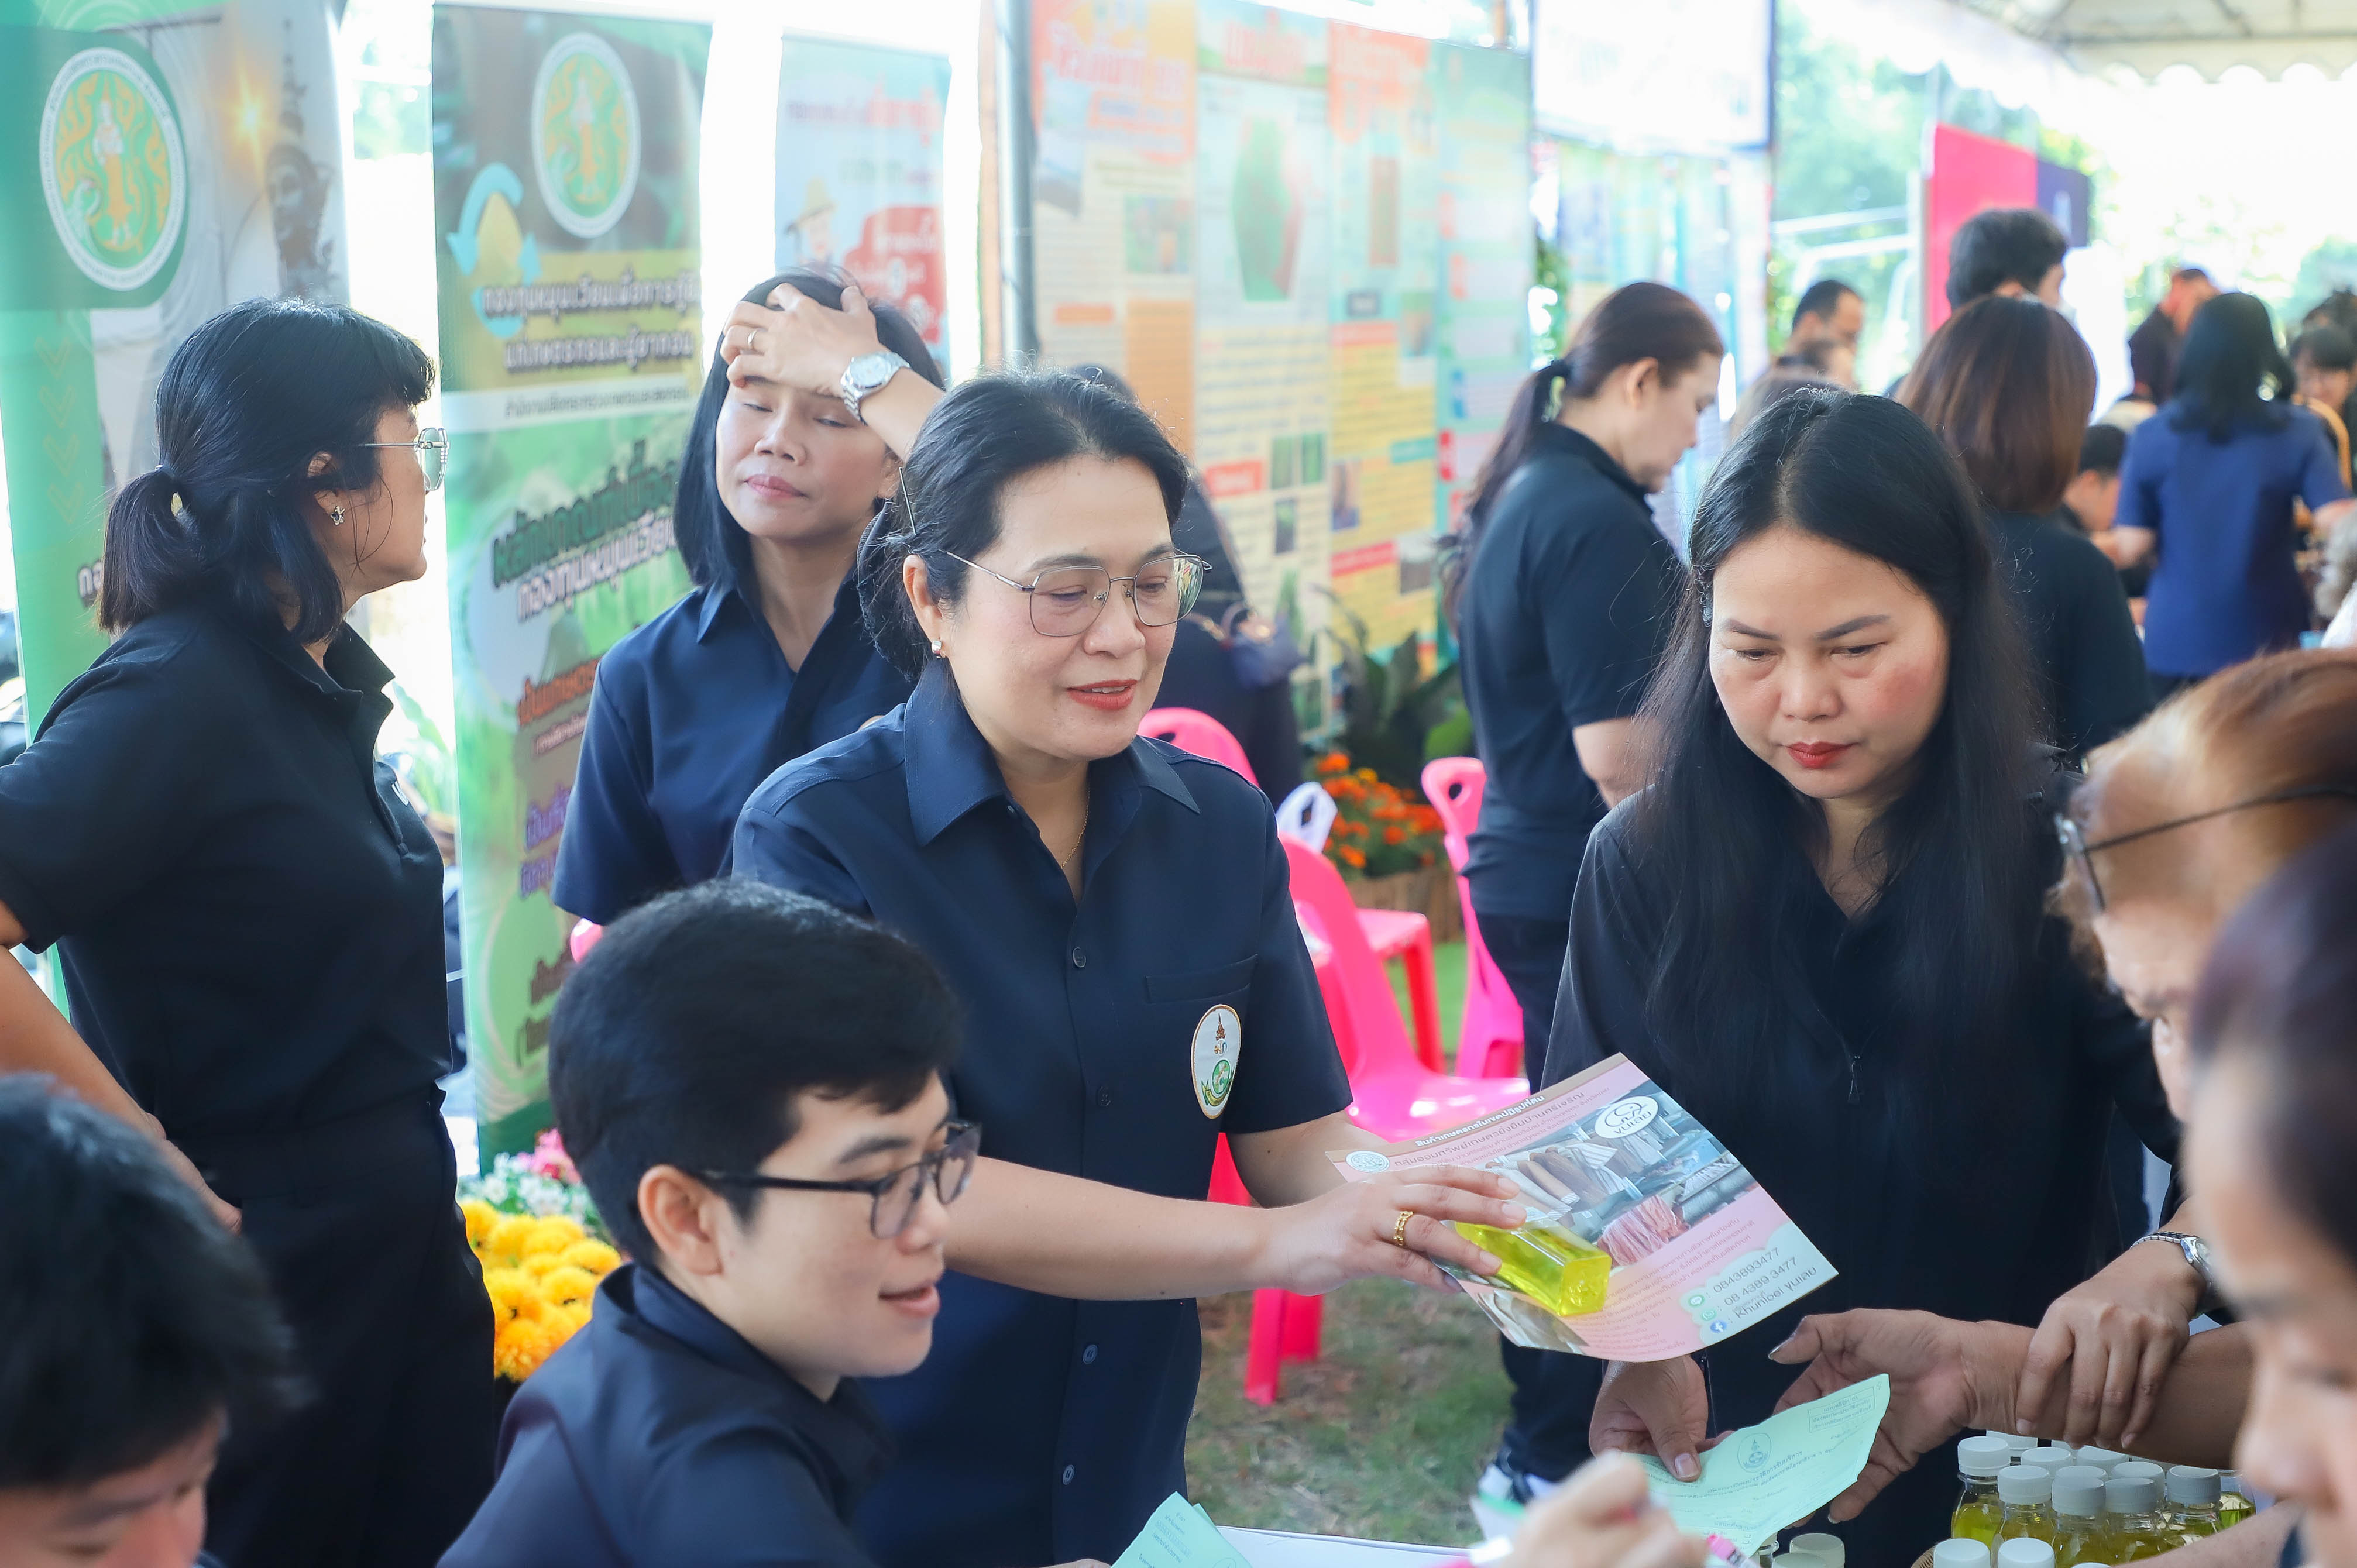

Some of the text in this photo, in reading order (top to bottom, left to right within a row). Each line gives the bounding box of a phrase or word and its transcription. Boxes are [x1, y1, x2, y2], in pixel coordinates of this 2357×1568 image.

[483, 267, 700, 322] กองทุนหมุนเวียนเพื่อการกู้ยื
[1713, 1247, 1779, 1293] 0843893477
[1724, 1293, 1741, 1306] 08
[1743, 1275, 1770, 1295] 4389
[1772, 1256, 1797, 1280] 3477
